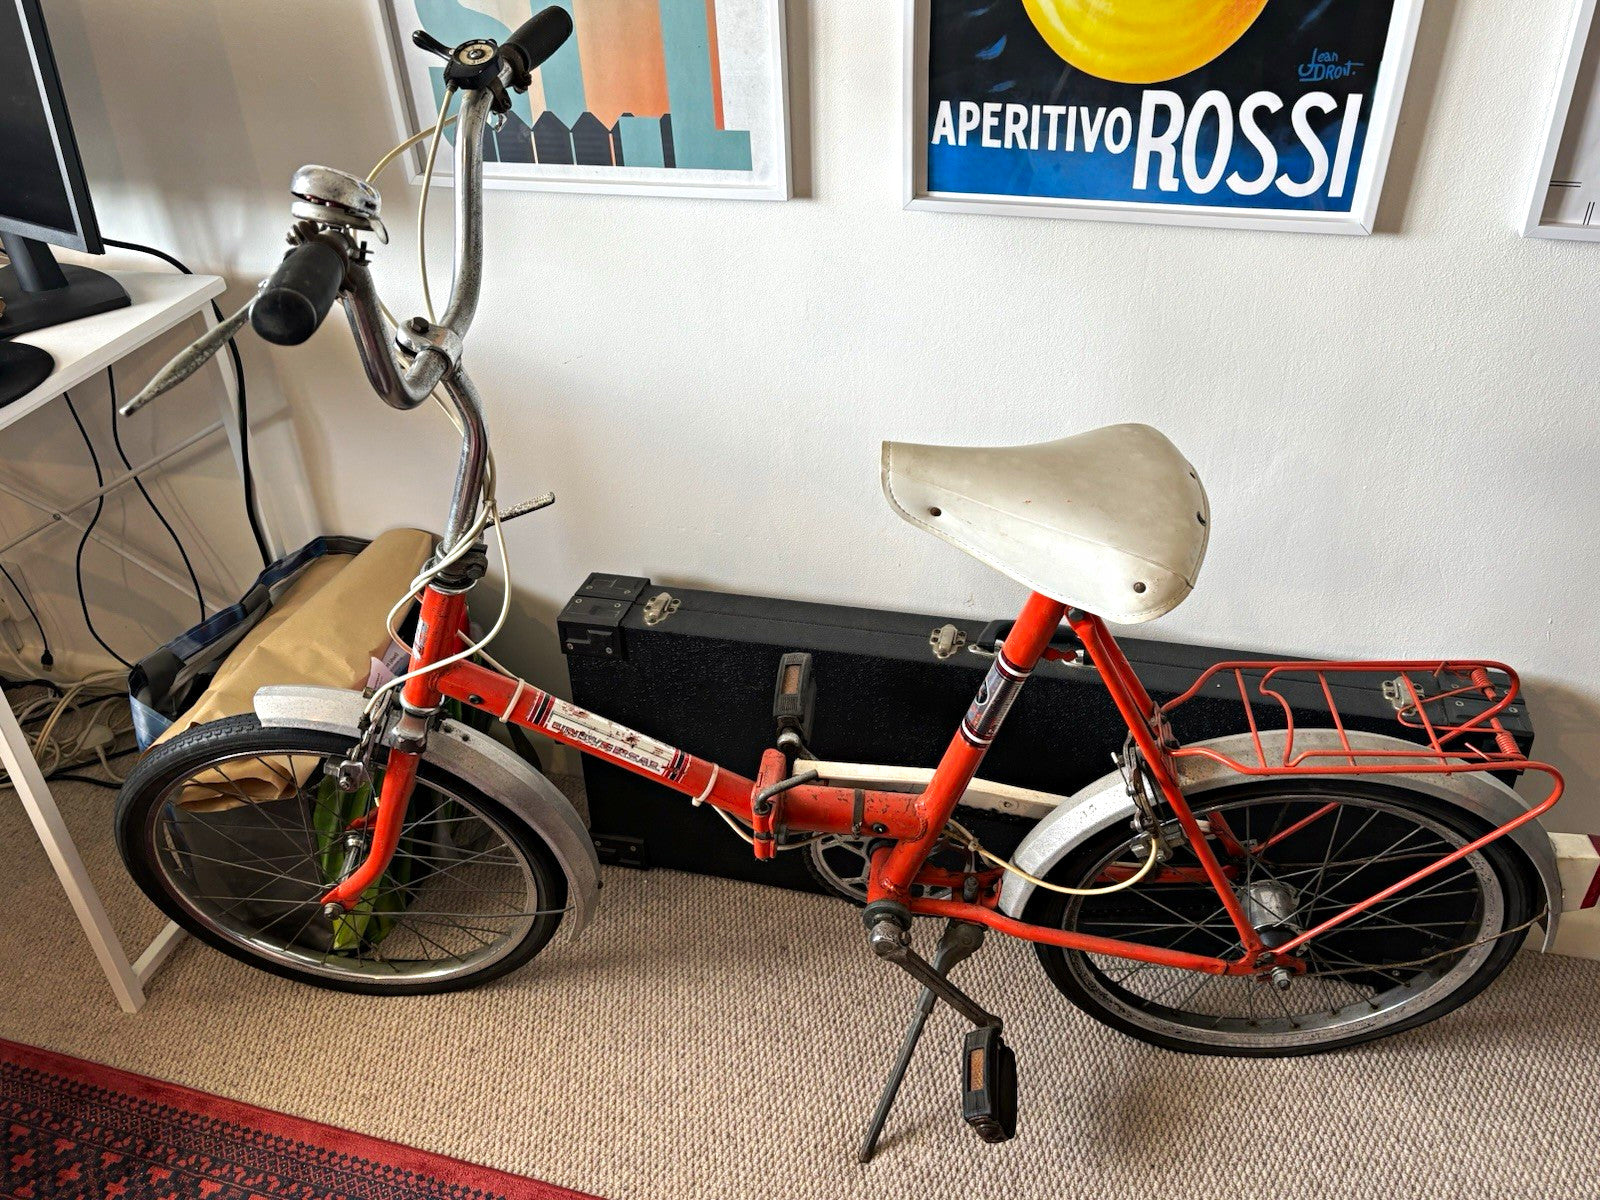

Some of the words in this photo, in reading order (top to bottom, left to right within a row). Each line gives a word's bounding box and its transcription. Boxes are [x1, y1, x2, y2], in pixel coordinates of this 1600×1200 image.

[1298, 47, 1339, 78] Jean
[931, 99, 1133, 155] APERITIVO
[1132, 89, 1364, 198] ROSSI
